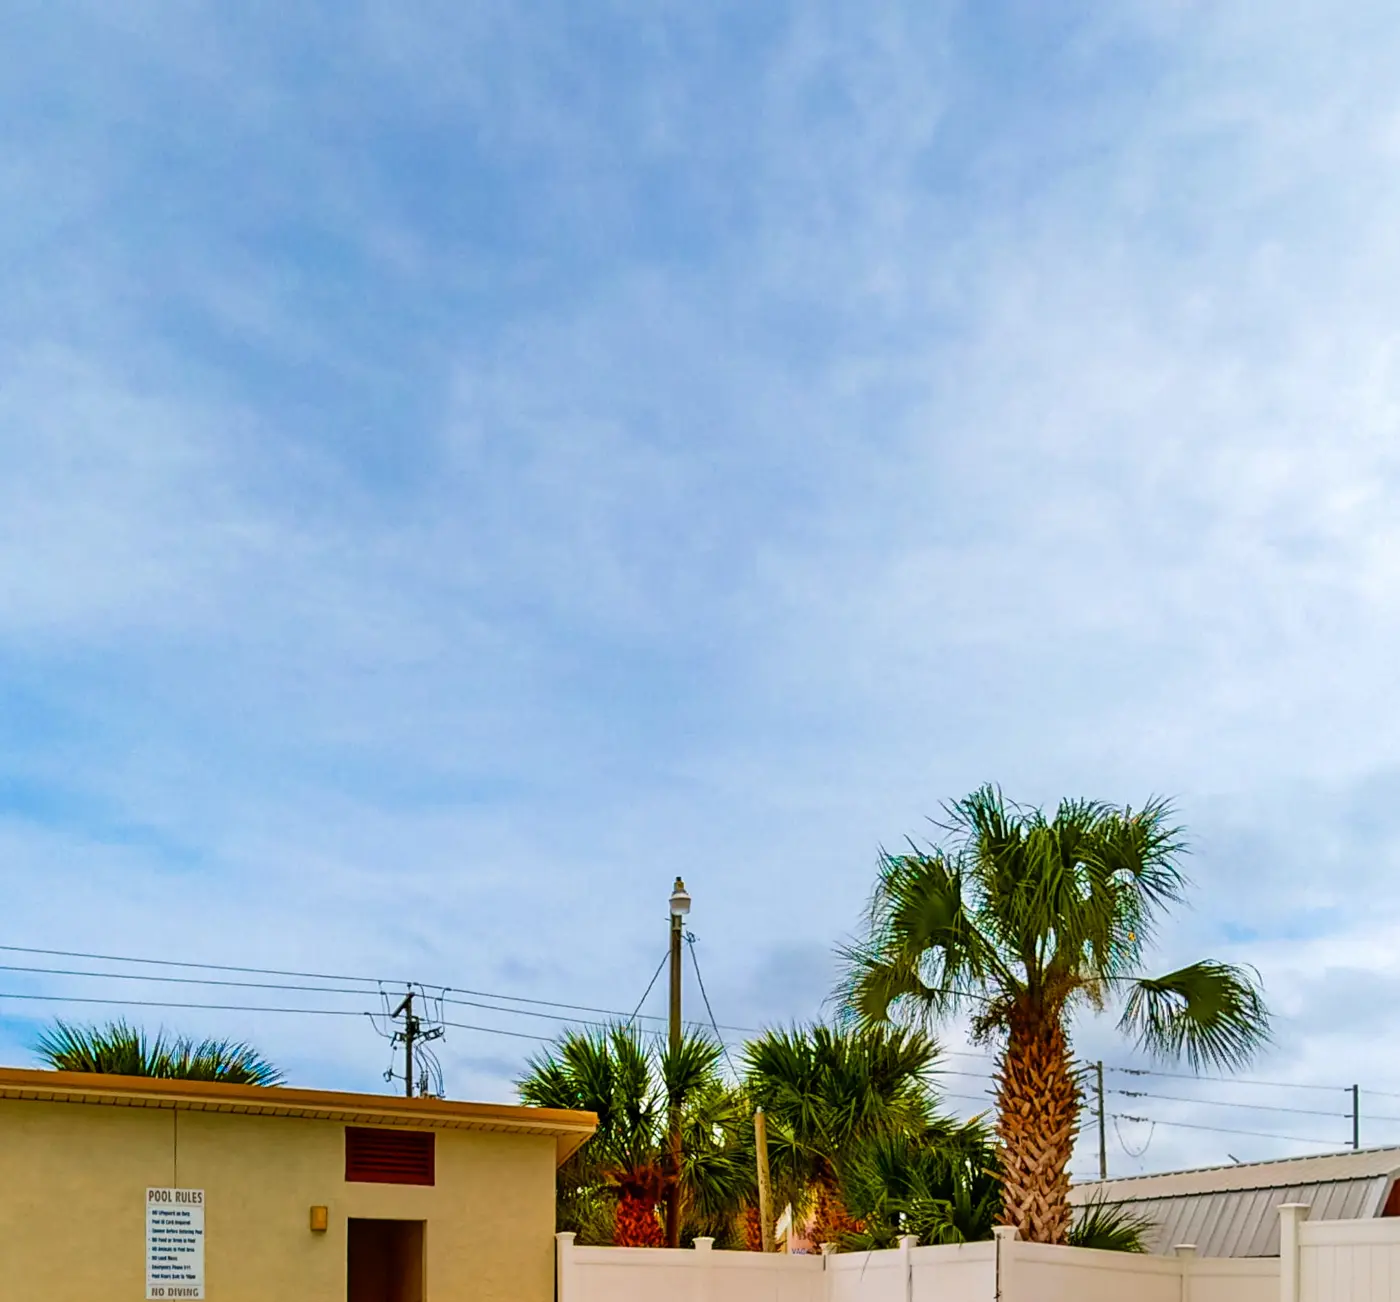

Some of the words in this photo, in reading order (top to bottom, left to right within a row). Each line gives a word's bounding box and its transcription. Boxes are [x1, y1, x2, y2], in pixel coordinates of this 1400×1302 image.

[148, 1190, 172, 1202] POOL
[175, 1191, 203, 1203] RULES
[152, 1288, 165, 1297] NO
[168, 1288, 199, 1297] DIVING
